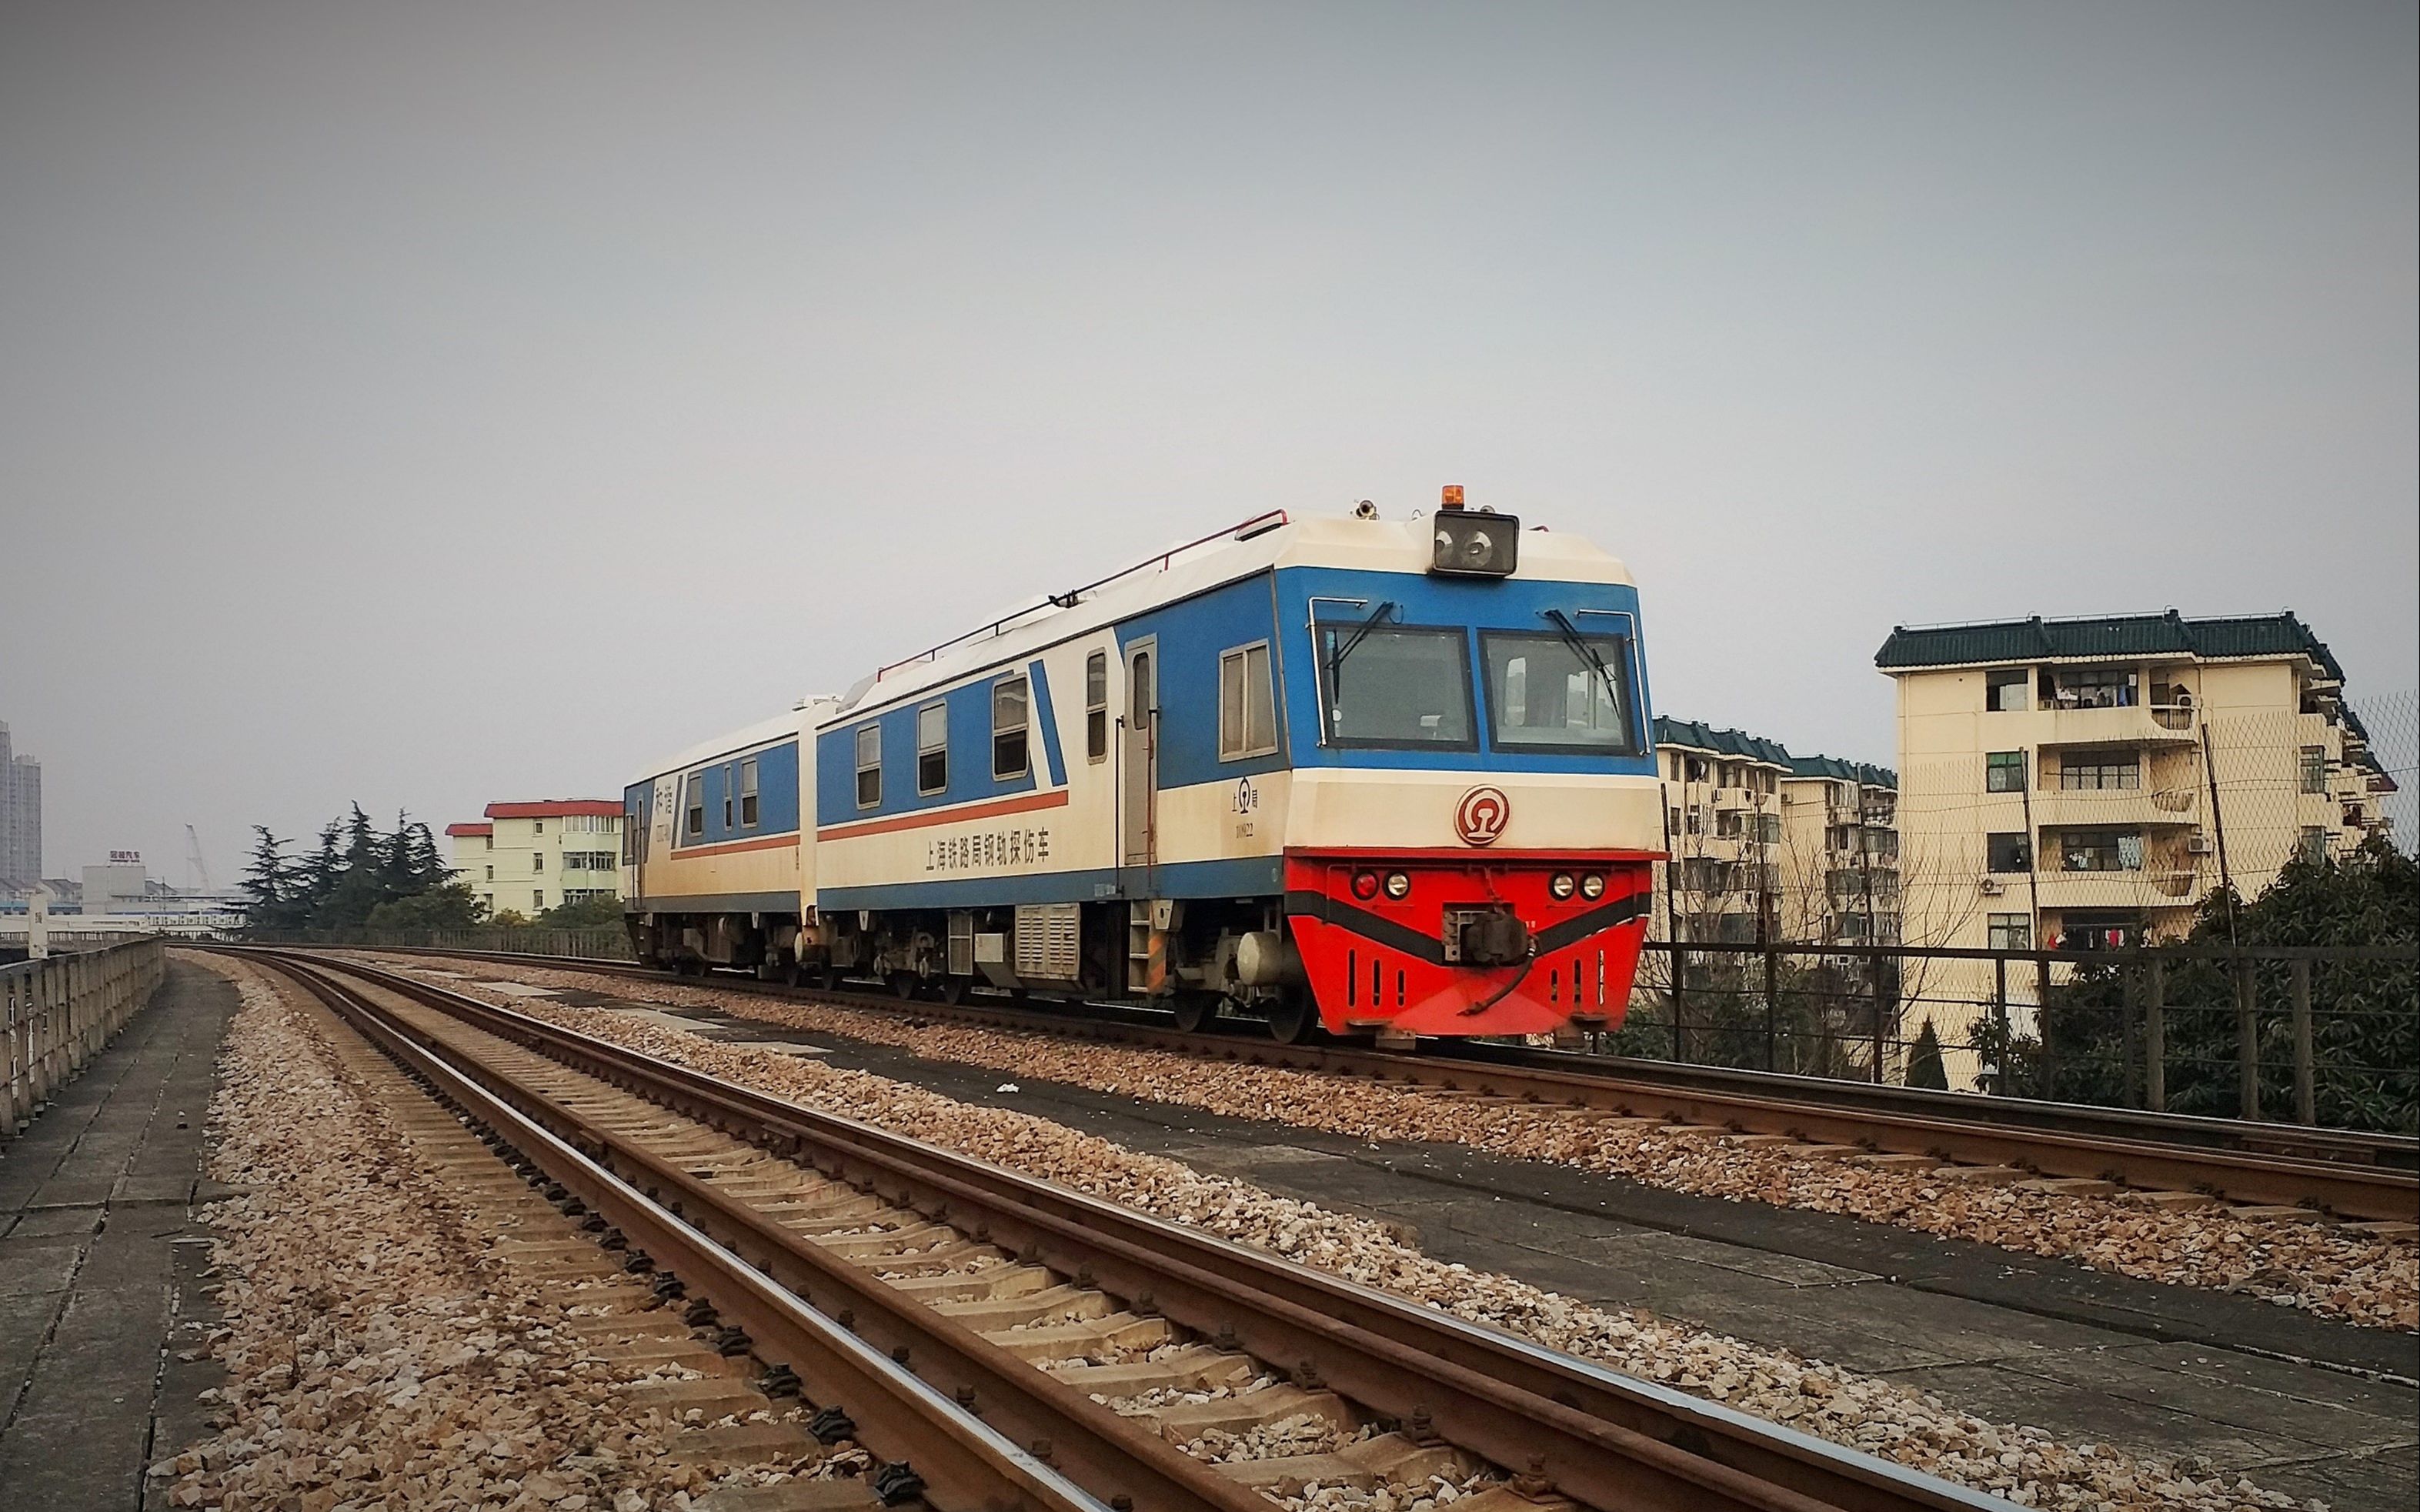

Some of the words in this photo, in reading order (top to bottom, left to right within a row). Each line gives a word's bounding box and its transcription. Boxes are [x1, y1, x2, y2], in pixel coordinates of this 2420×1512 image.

[926, 826, 1049, 871] 上海铁路局钢轨探伤车
